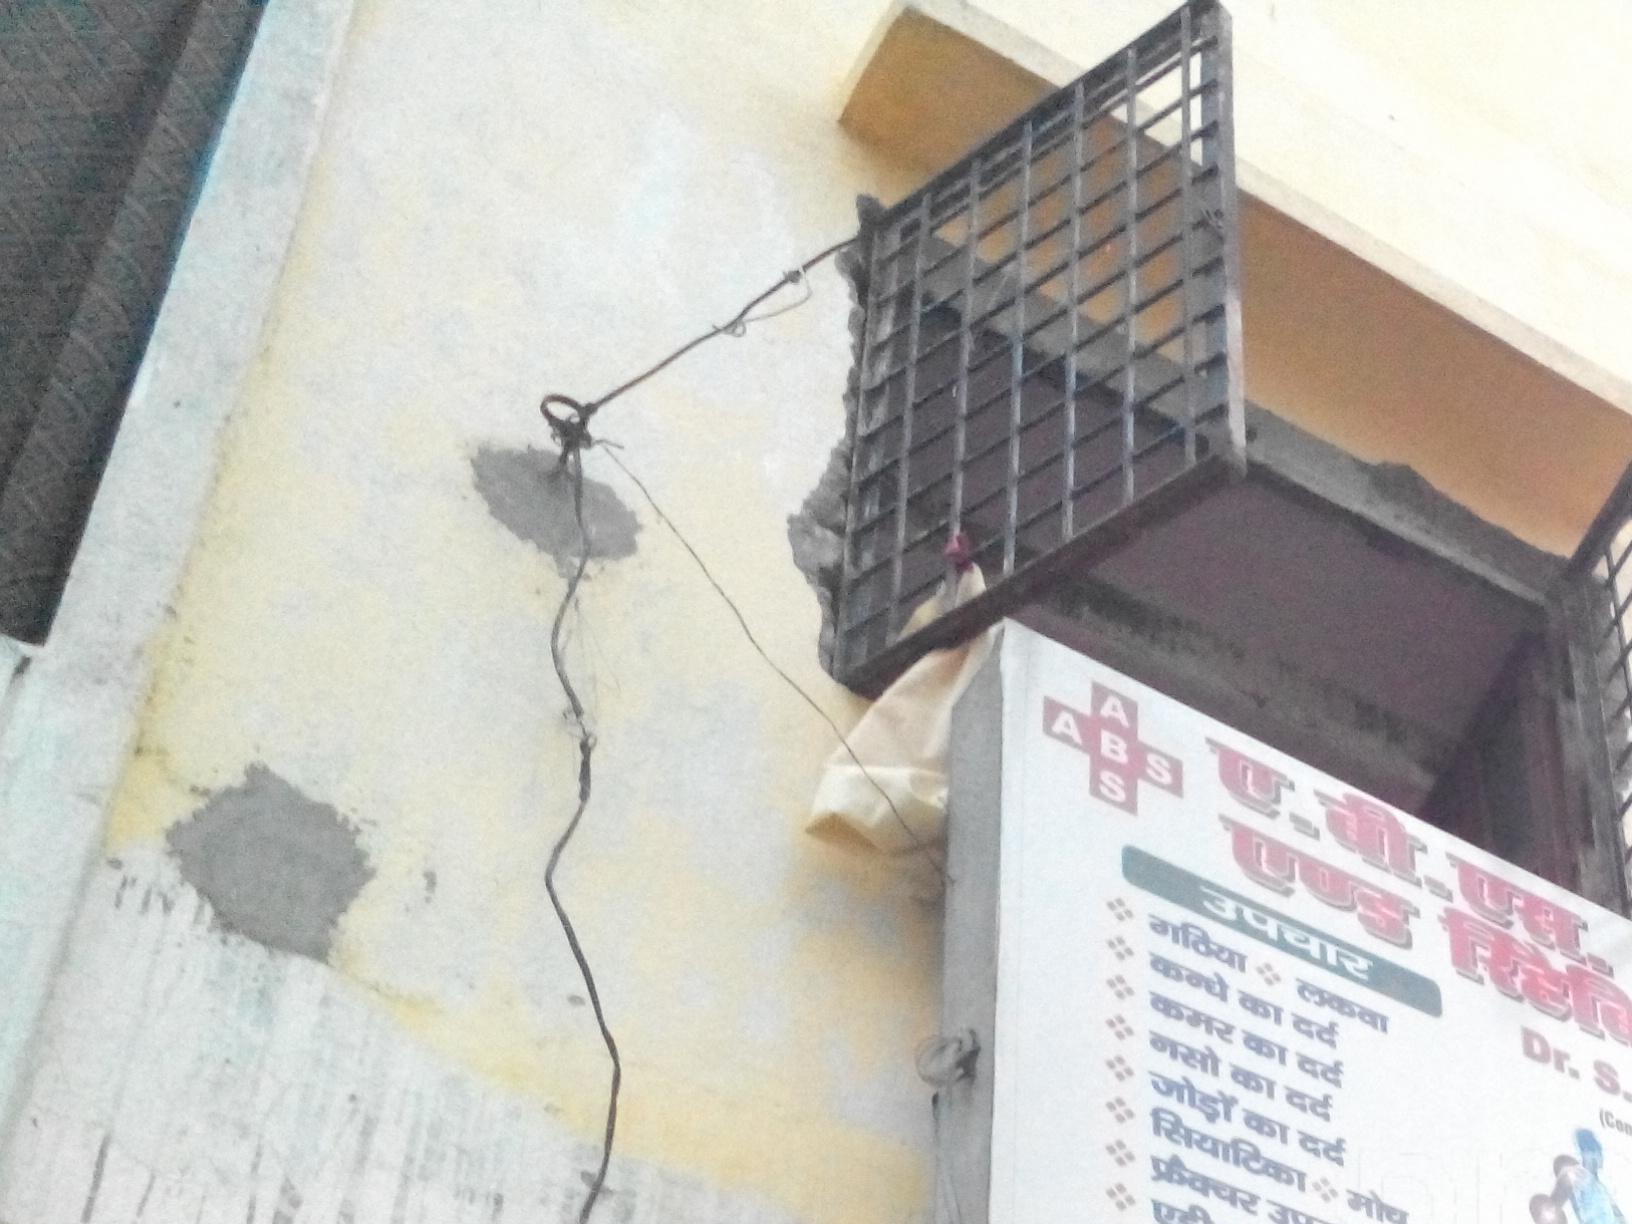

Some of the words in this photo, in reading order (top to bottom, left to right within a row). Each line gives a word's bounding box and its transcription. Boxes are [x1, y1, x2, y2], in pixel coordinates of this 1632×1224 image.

[1218, 814, 1421, 951] एण्ड
[1149, 914, 1247, 973] गठिया
[1296, 978, 1389, 1034] लकवा
[1197, 888, 1373, 980] उपचार
[1149, 991, 1235, 1044] कमर
[1242, 1030, 1288, 1066] का
[1296, 1052, 1344, 1089] दर्द
[1238, 990, 1283, 1026] का
[1291, 1013, 1338, 1049] दर्द
[1521, 1026, 1580, 1079] Dr.
[1230, 1064, 1276, 1100] का
[1285, 1086, 1333, 1123] दर्द
[1149, 1107, 1307, 1192] सियाटिका
[1243, 1108, 1289, 1145] का
[1297, 1130, 1346, 1167] दर्द
